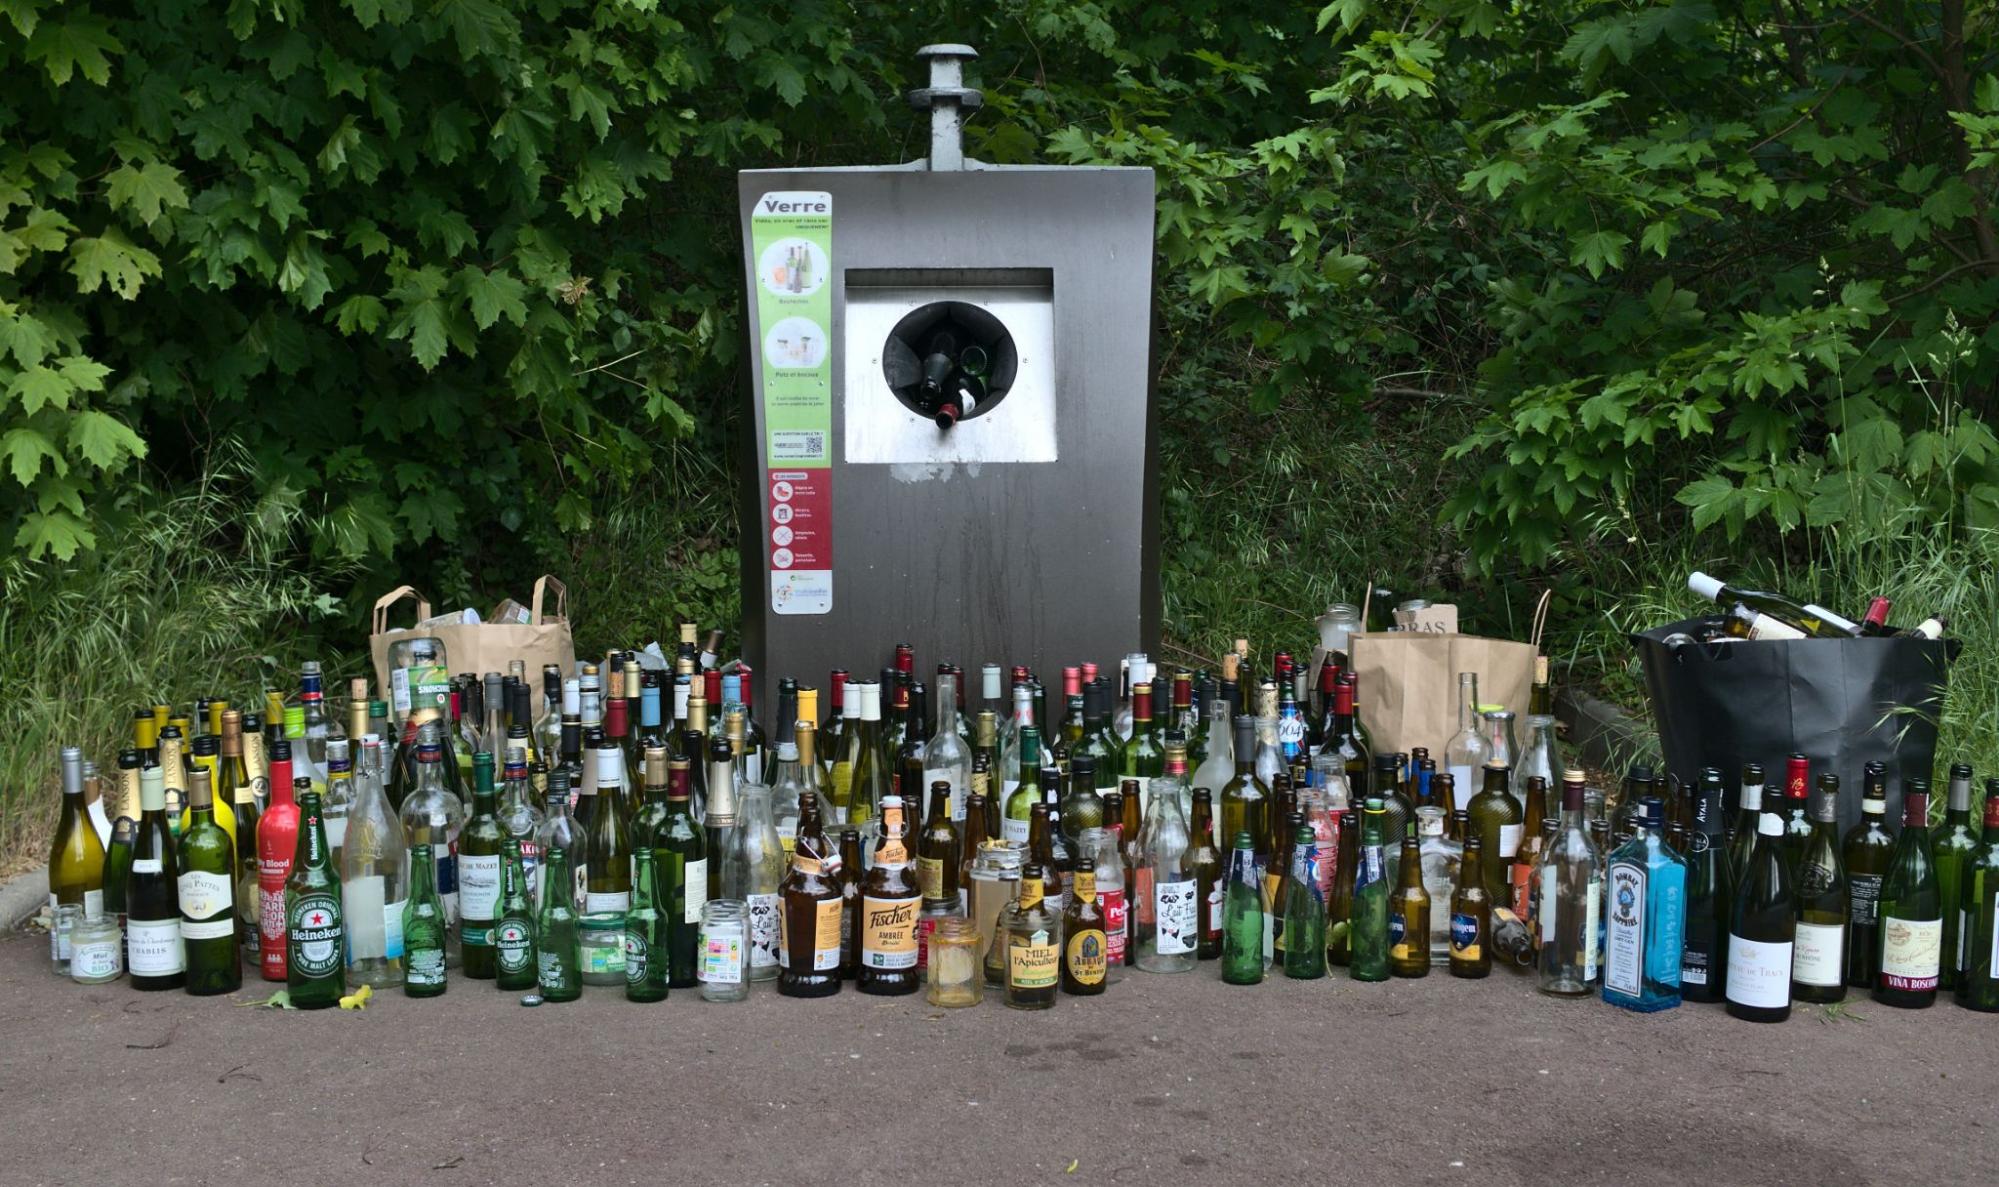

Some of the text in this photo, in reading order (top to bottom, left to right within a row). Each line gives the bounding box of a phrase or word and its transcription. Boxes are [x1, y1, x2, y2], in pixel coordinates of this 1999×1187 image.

[765, 201, 827, 214] Verre
[167, 744, 176, 785] LANSON
[120, 773, 130, 811] LANSON
[1696, 797, 1707, 823] AYALA
[310, 825, 318, 861] Heineken
[886, 848, 904, 859] Fischer
[266, 859, 290, 869] Blood
[475, 862, 498, 871] MAZET
[1615, 872, 1639, 888] BOMBAY
[294, 901, 339, 924] HEINEKEN ORIGINAL
[869, 902, 913, 929] Fischer
[1611, 912, 1638, 927] SAPPHIRE
[291, 927, 342, 942] Heineken
[878, 931, 904, 941] AMBRÉE
[131, 946, 167, 956] CHABLIS
[497, 939, 532, 950] Heineken
[295, 949, 340, 971] PURE MALT LAGER
[1025, 948, 1052, 959] MIEL
[1014, 956, 1057, 969] l'Apiculteur
[1759, 966, 1784, 978] TRACY
[1888, 975, 1908, 988] VIÑA
